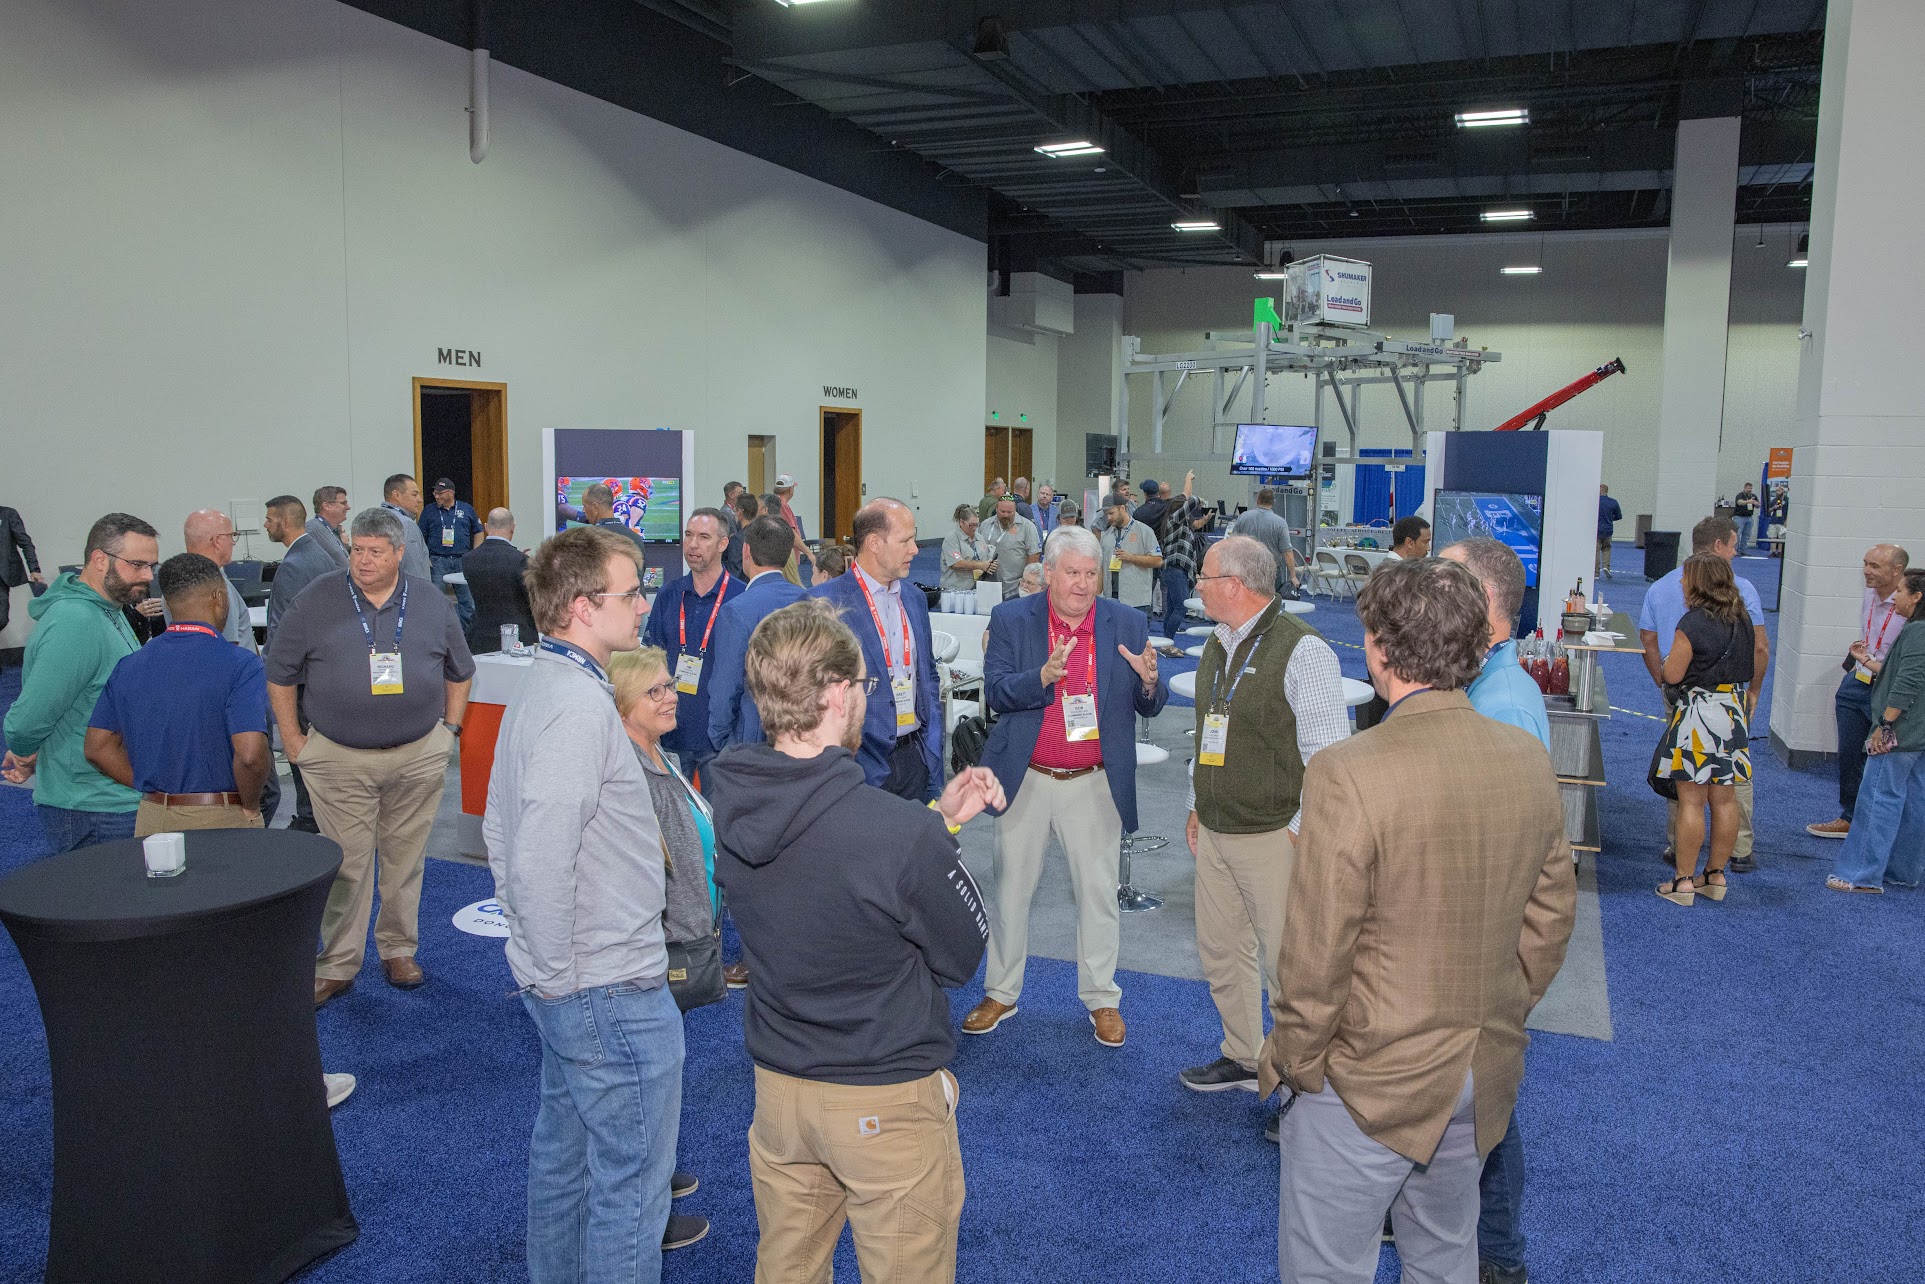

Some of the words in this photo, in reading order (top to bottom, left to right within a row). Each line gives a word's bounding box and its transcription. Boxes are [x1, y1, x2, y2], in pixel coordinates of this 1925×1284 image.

[1337, 272, 1367, 282] SHUMAKER
[437, 347, 481, 368] MEN
[823, 385, 858, 400] WOMEN
[617, 504, 627, 513] 24
[566, 650, 586, 664] NRMCA
[947, 870, 956, 879] A
[956, 880, 976, 912] SOLID
[976, 912, 988, 939] NAME
